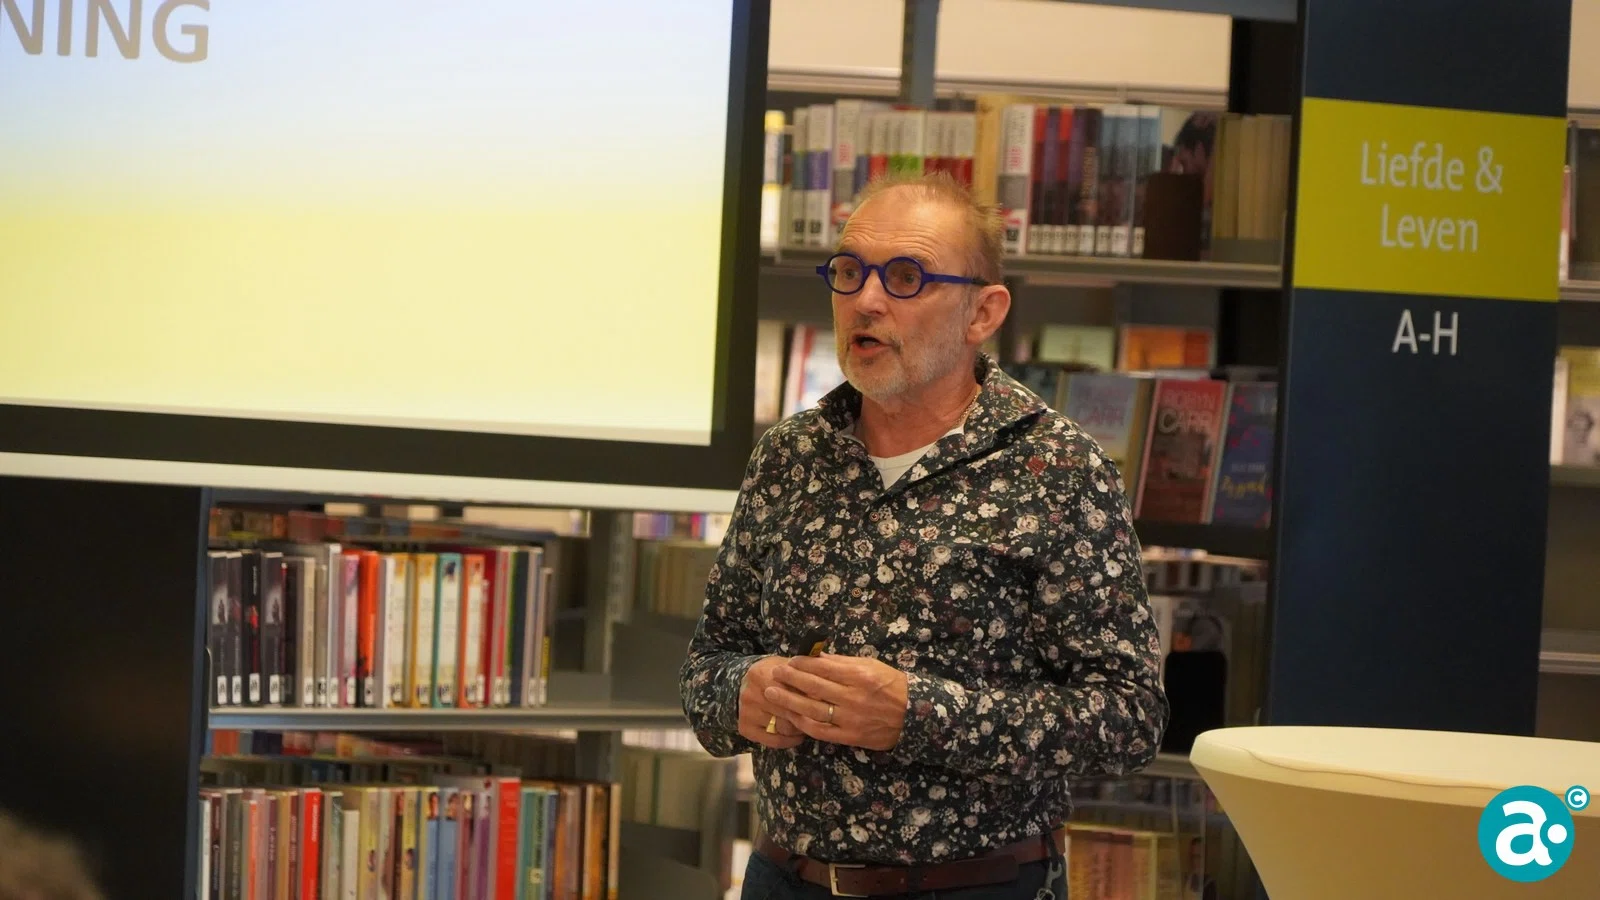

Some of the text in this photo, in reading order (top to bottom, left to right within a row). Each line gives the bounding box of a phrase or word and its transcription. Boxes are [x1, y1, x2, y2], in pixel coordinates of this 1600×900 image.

[0, 0, 210, 64] NING
[1360, 140, 1503, 193] Liefde &
[1380, 203, 1479, 252] Leven
[1392, 309, 1459, 356] A-H
[1159, 405, 1213, 434] CARR
